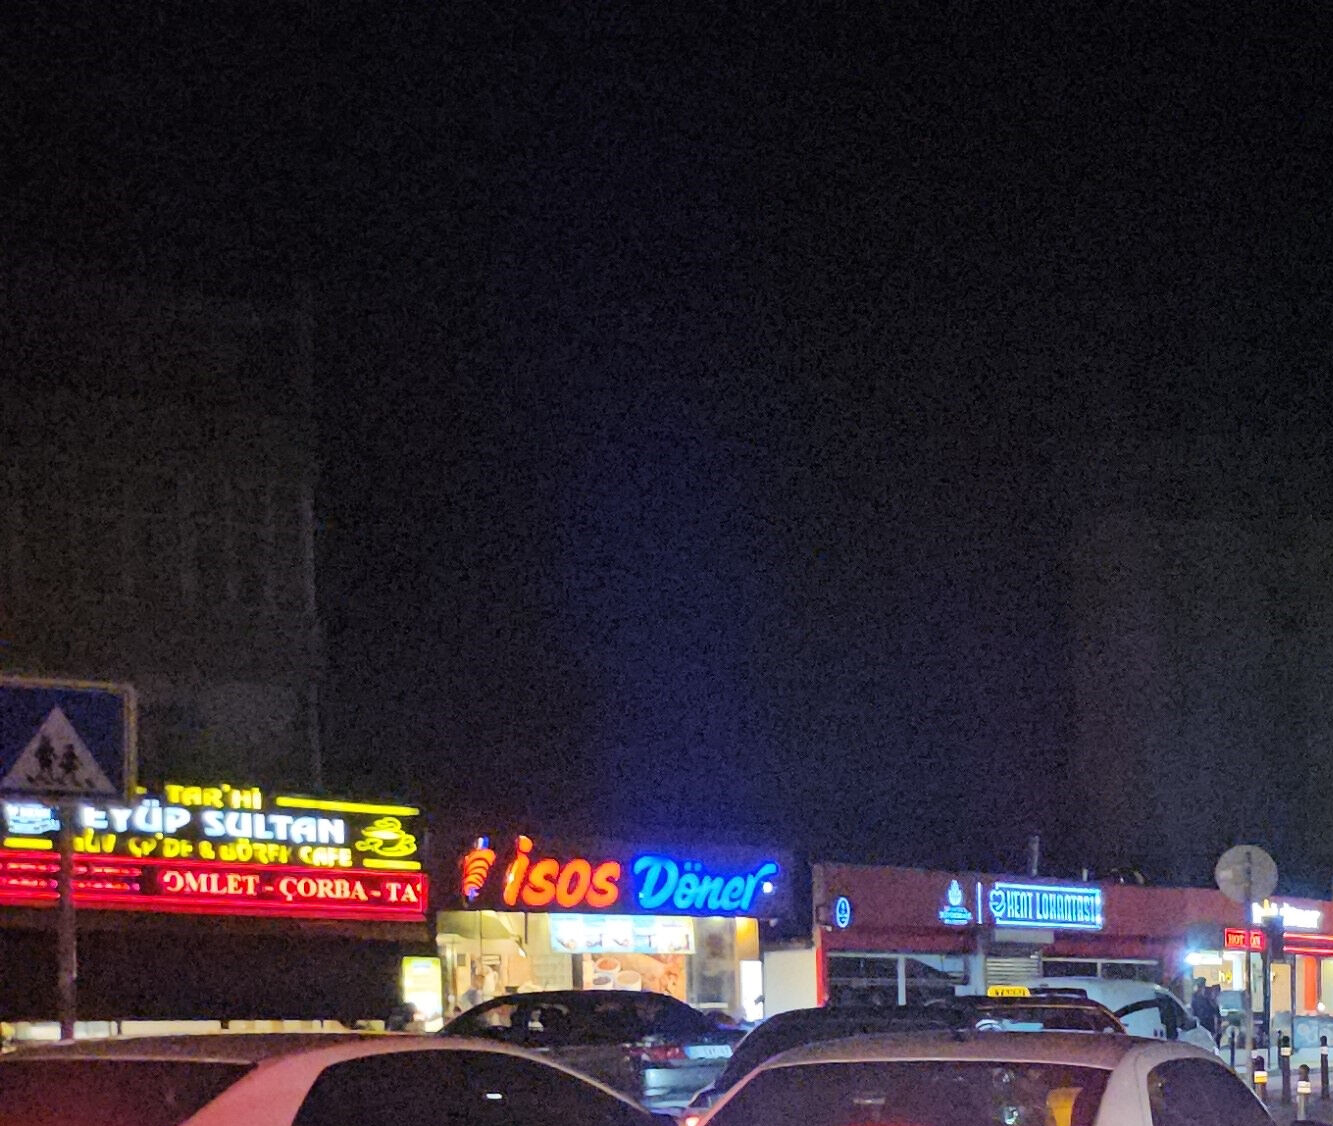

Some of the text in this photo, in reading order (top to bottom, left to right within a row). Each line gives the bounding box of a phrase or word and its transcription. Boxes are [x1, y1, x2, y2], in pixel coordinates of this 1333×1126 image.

[79, 798, 190, 834] EYÜP
[201, 810, 345, 845] SULTAN
[278, 877, 369, 901] ÇORBA
[632, 855, 779, 911] Döner
